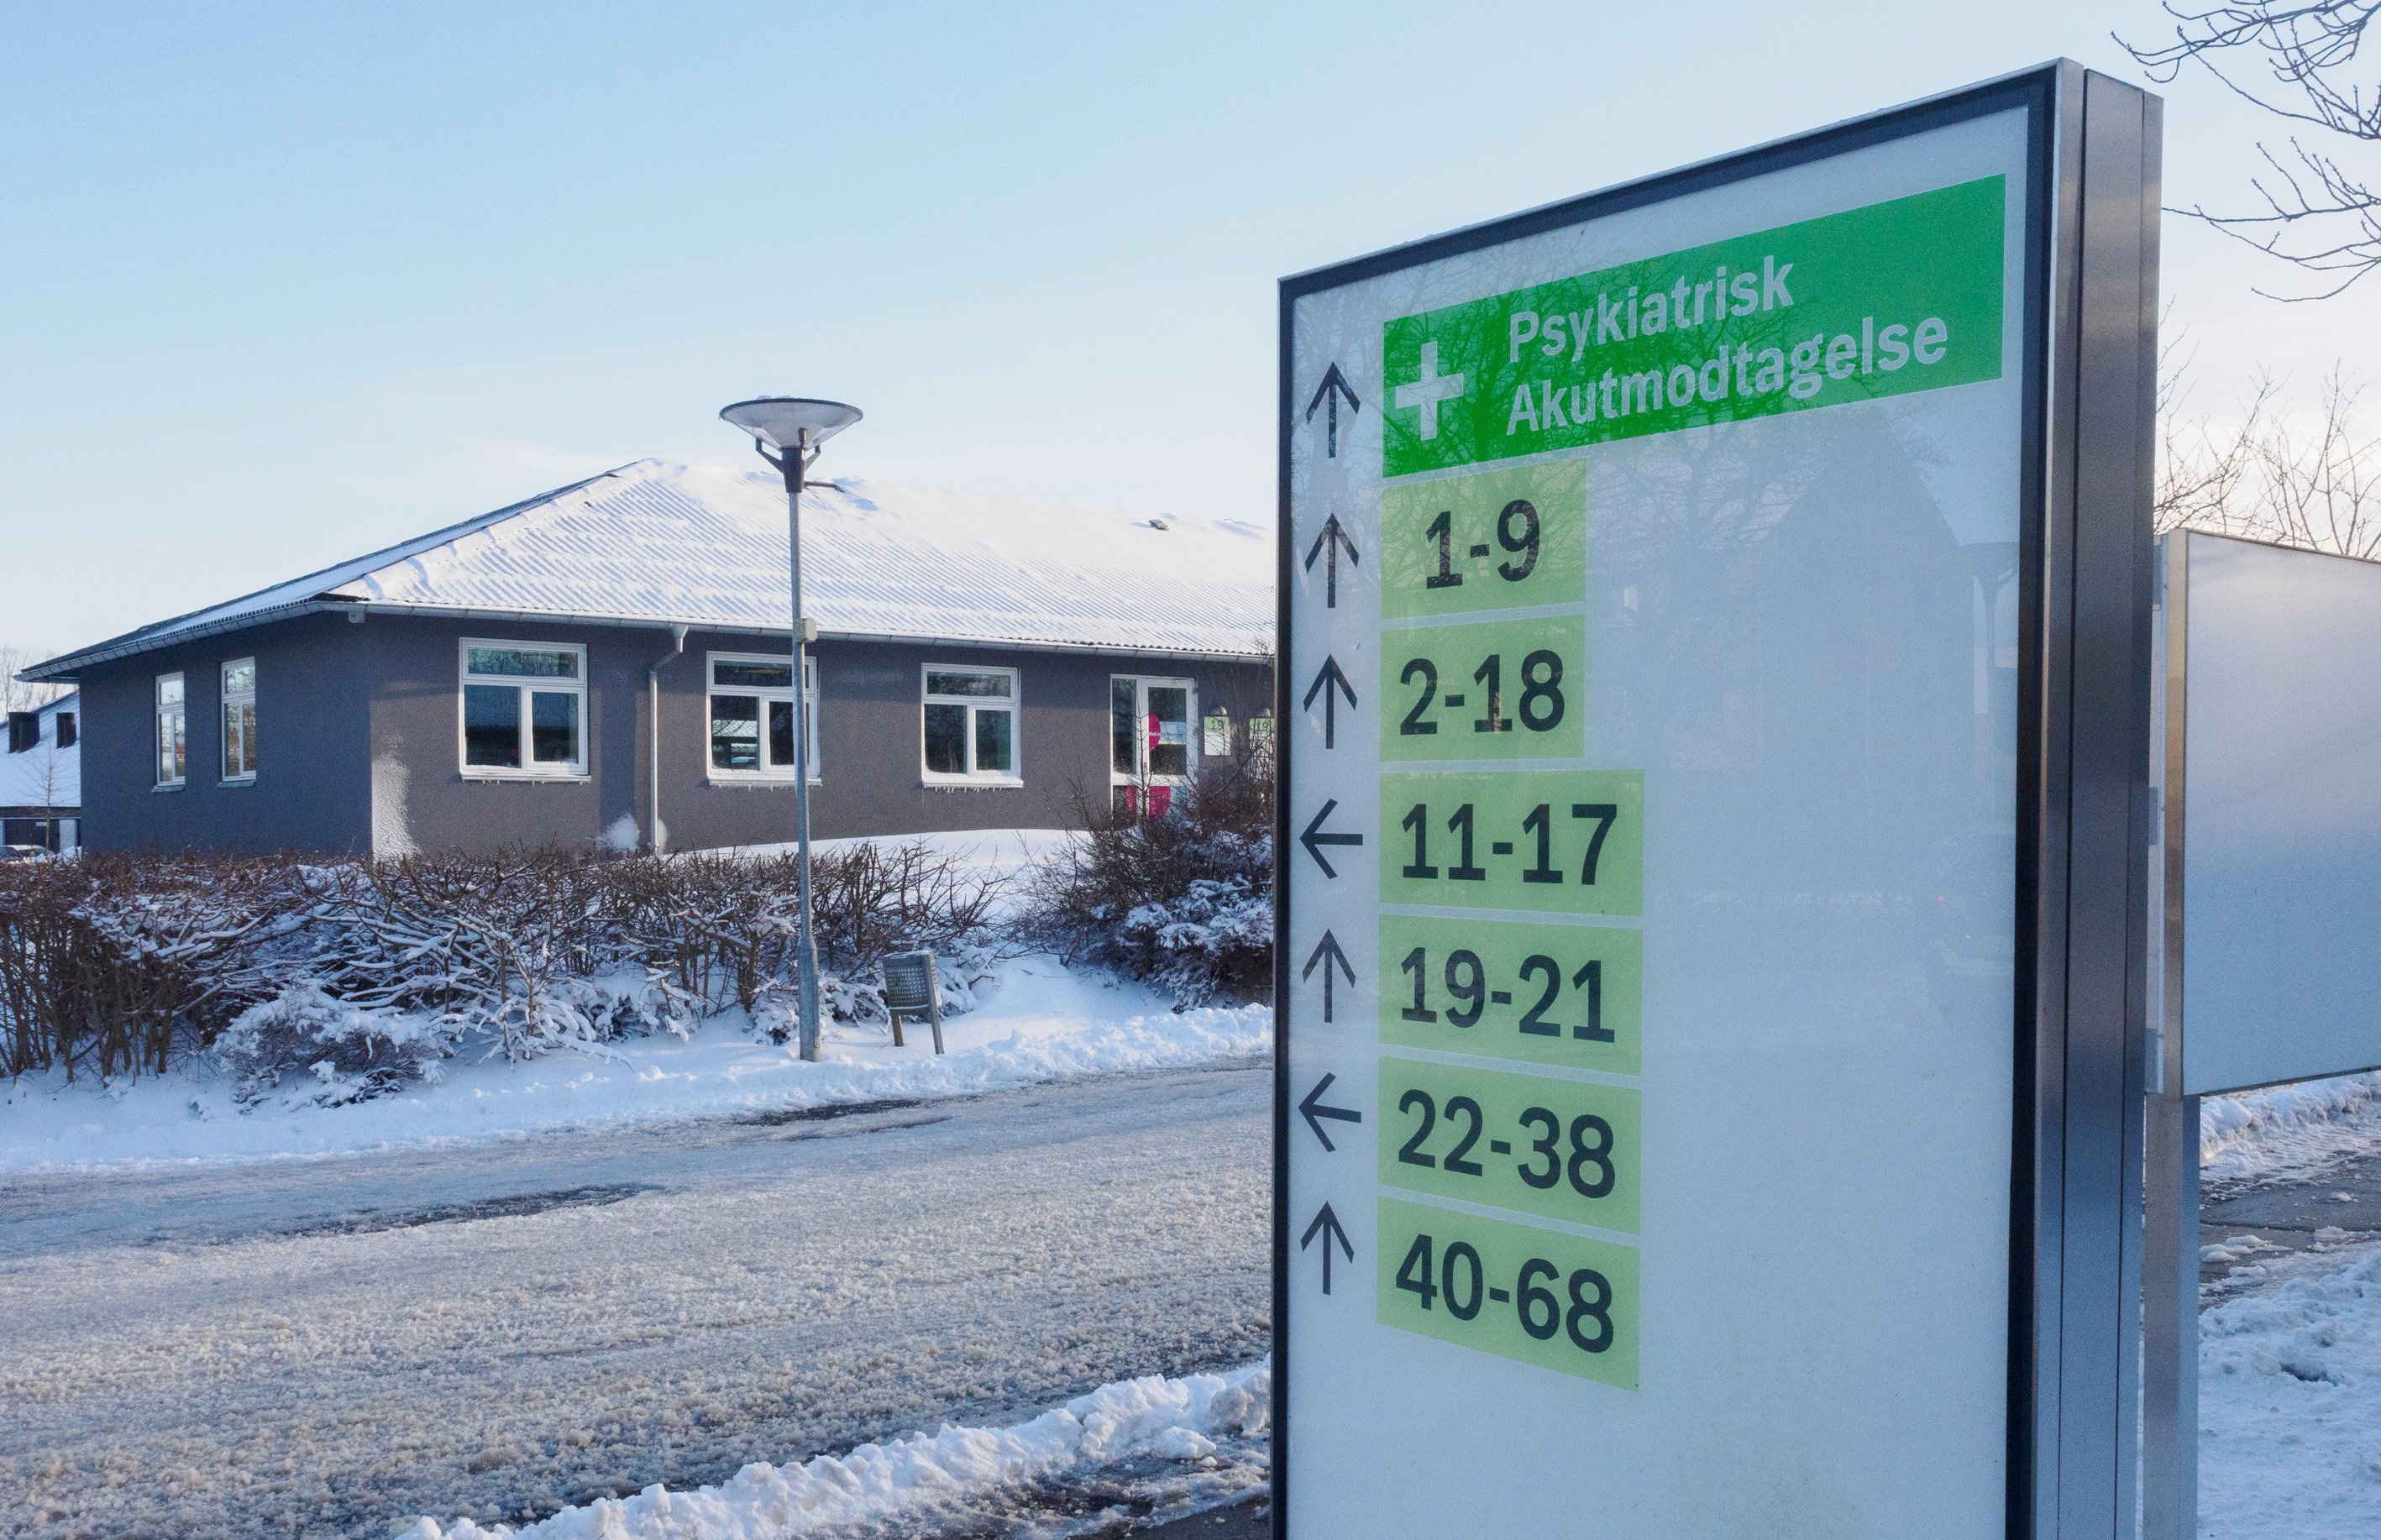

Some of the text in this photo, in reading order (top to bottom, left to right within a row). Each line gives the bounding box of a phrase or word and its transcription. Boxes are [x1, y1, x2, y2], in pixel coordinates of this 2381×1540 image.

[1510, 254, 1795, 363] Psykiatrisk
[1506, 316, 1948, 436] Akutmodtagelse
[1425, 499, 1541, 589] 1-9
[1210, 720, 1224, 731] 19
[1399, 649, 1565, 736] 2-18
[1401, 803, 1618, 886] 11-17
[1400, 946, 1615, 1043] 19-21
[1398, 1088, 1616, 1199] 22-38
[1395, 1234, 1614, 1354] 40-68
